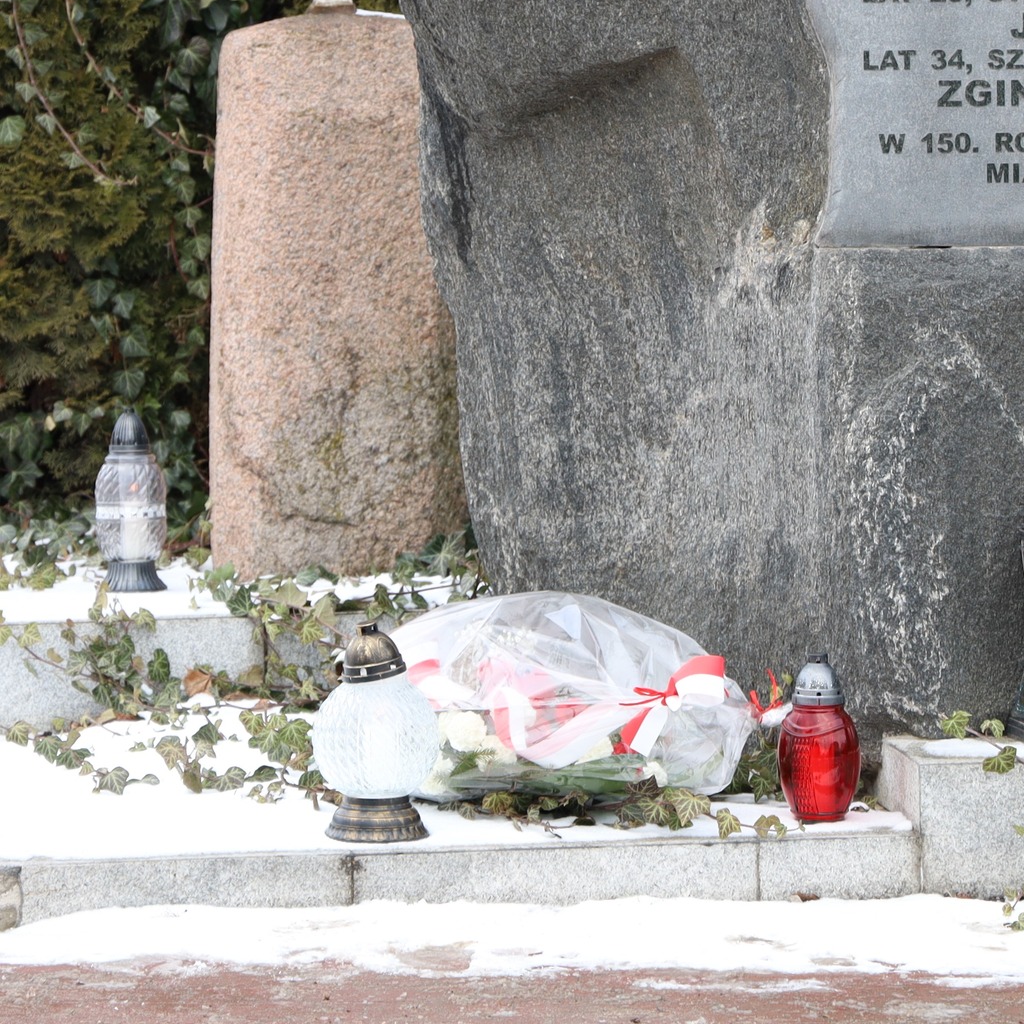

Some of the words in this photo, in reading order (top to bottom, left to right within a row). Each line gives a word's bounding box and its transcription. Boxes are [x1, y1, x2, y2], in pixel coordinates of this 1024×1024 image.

[863, 49, 917, 71] LAT
[931, 49, 973, 75] 34,
[879, 133, 905, 154] W
[921, 132, 979, 154] 150.
